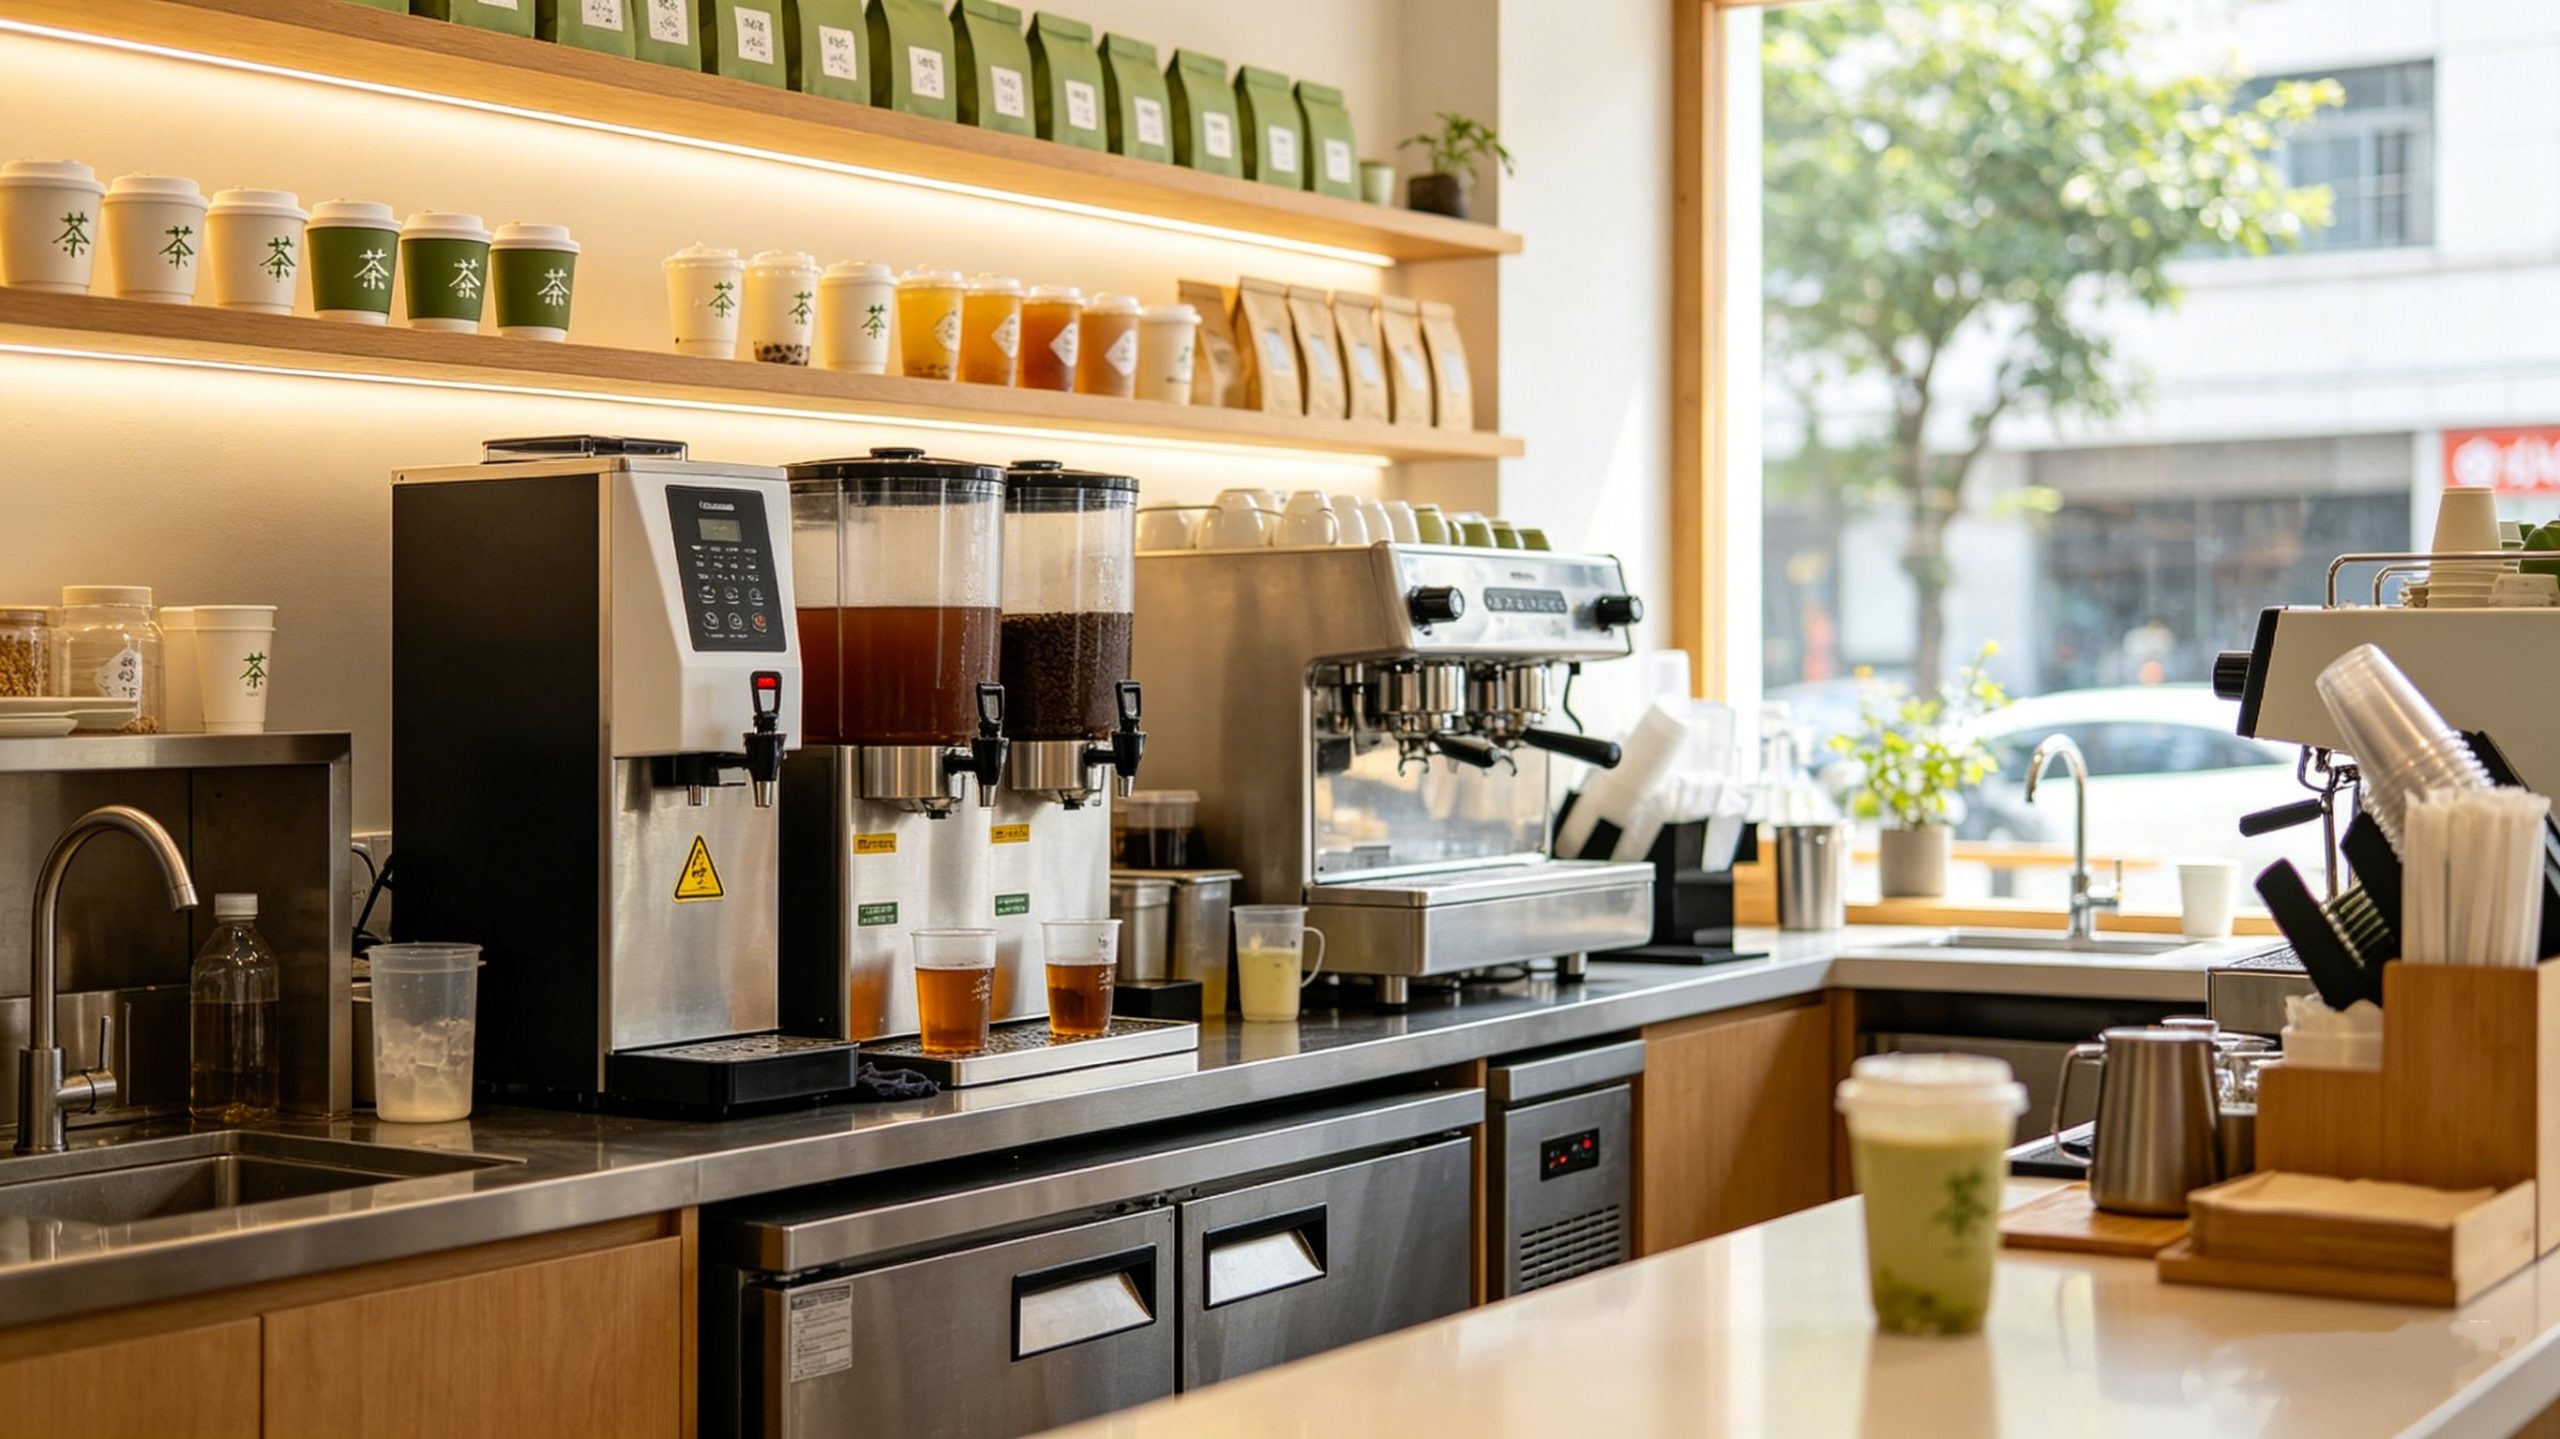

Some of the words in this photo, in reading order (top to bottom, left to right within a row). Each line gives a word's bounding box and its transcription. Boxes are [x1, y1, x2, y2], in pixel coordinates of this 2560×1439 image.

[53, 210, 90, 259] 茶
[158, 224, 195, 269] 茶
[259, 234, 296, 284] 茶
[353, 248, 391, 292] 茶
[448, 257, 482, 301] 茶
[536, 267, 571, 308] 茶
[708, 280, 737, 320] 茶
[787, 289, 813, 326] 茶
[861, 304, 887, 340] 茶
[239, 651, 268, 689] 茶
